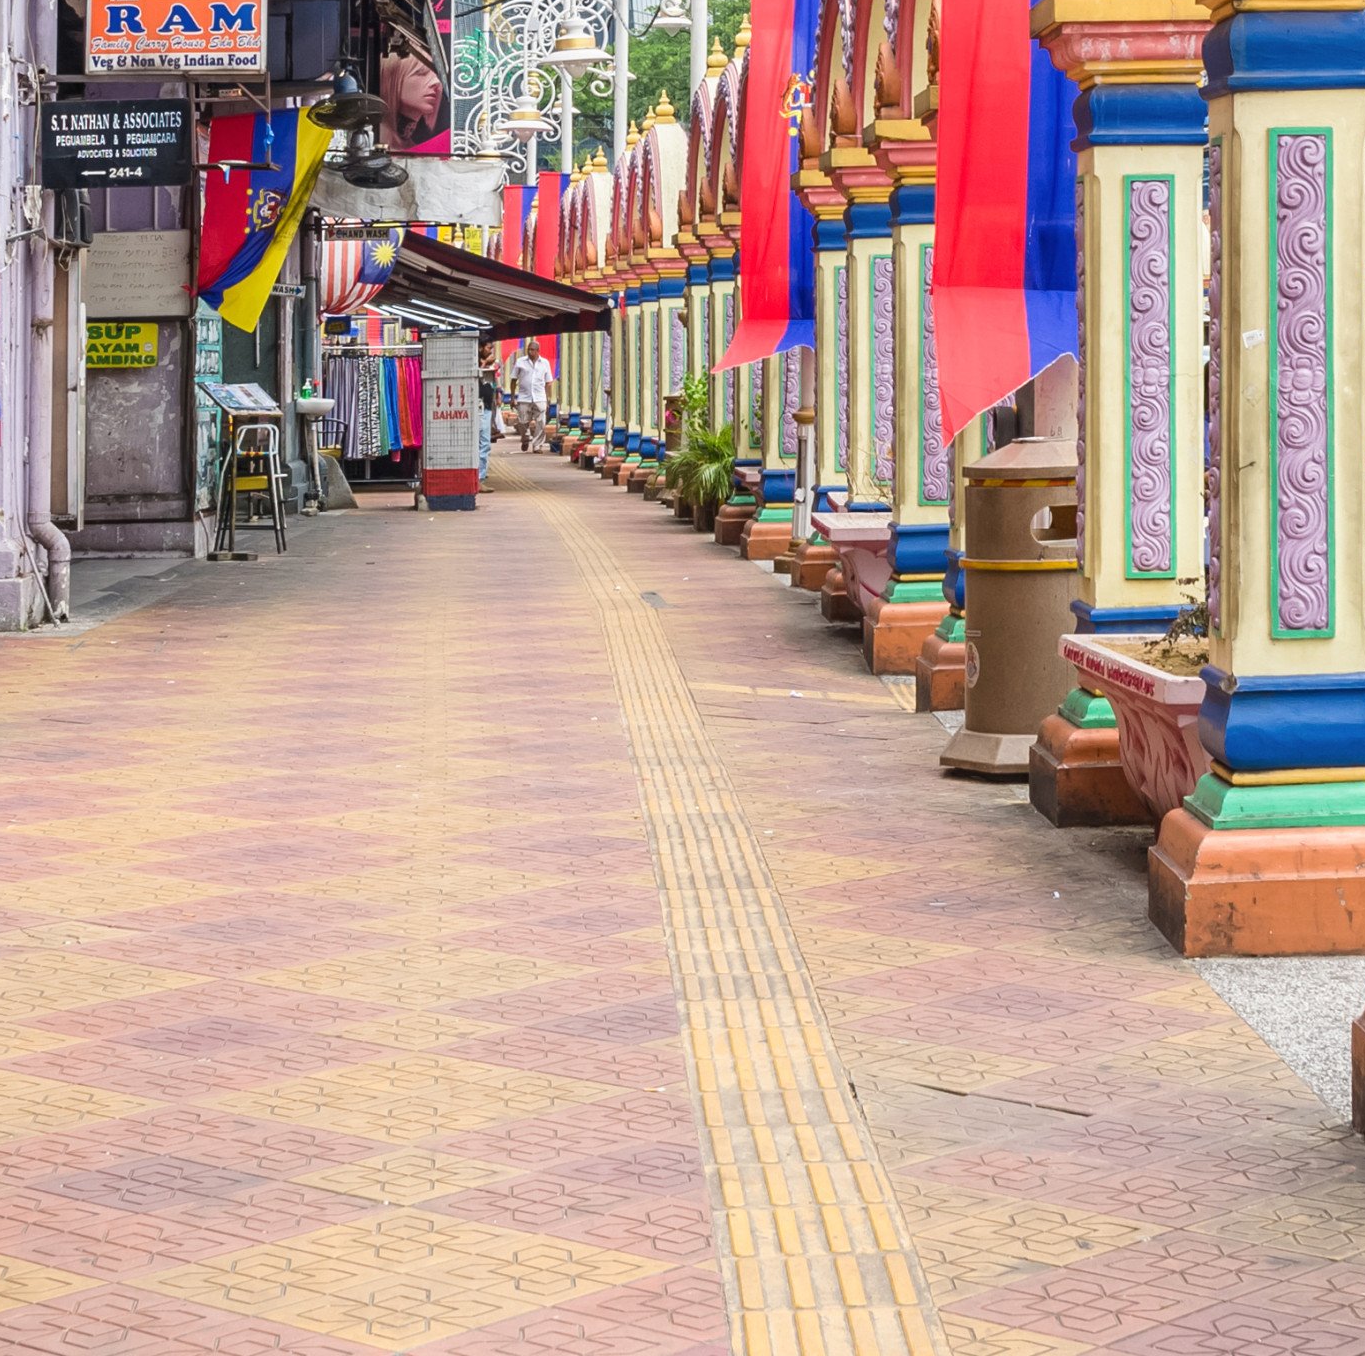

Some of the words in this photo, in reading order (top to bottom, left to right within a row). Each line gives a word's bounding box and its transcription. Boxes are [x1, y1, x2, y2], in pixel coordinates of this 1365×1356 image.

[104, 2, 258, 35] RAM
[91, 37, 131, 52] Family
[135, 35, 168, 51] Curry
[171, 35, 205, 49] House
[209, 35, 233, 49] Sdn
[236, 34, 261, 48] Bhd
[92, 55, 114, 72] Veg
[117, 55, 128, 68] &
[130, 55, 156, 68] Non
[159, 54, 182, 69] Veg
[184, 53, 225, 66] Indian
[227, 53, 258, 66] Food
[51, 114, 60, 131] S.
[61, 114, 69, 131] T.
[70, 113, 110, 131] NATHAN
[112, 113, 120, 130] &
[122, 110, 182, 129] ASSOCIATES
[55, 133, 106, 147] PEGUAMBELA
[126, 132, 176, 145] PEGUAMCARA
[77, 149, 113, 158] ADVOCATES
[115, 148, 120, 158] &
[122, 147, 157, 158] SOLICITORS
[109, 166, 142, 178] 241-4
[365, 228, 388, 239] WASH
[272, 284, 294, 295] WASH
[87, 325, 142, 340] SUP
[87, 342, 140, 353] AYAM
[432, 410, 469, 420] BAHAYA
